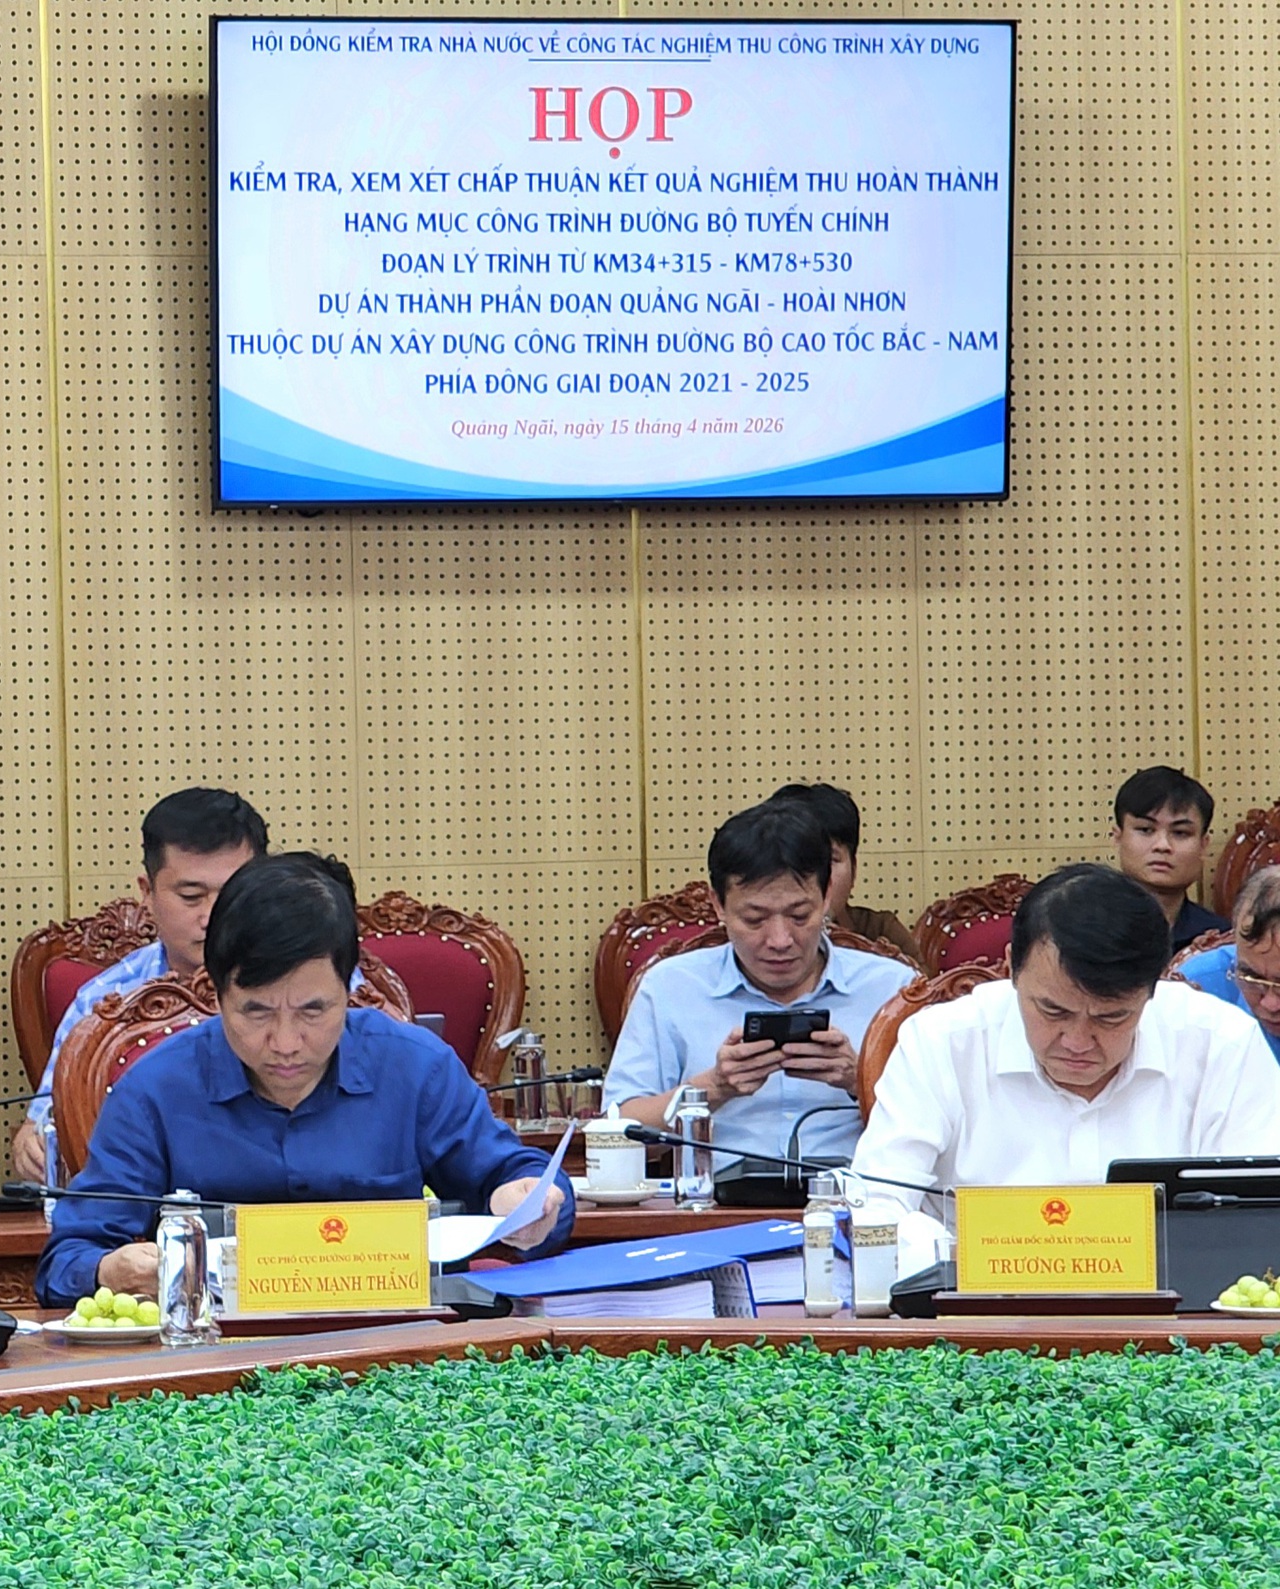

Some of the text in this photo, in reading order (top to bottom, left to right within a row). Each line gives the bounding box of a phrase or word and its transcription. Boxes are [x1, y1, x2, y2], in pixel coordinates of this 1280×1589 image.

[251, 27, 980, 59] HỘI ĐỒNG KIỂM TRA NHÀ NƯỚC VỀ CÔNG TÁC NGHIỆM THU CÔNG TRÌNH XÂY DỰNG
[527, 86, 695, 160] HỌP
[229, 160, 999, 198] KIỂM TRA, XEM XÉT CHẤP THUẬN KẾT QUẢ NGHIỆM THU HOÀN THÀNH
[344, 203, 889, 238] HẠNG MỤC CÔNG TRÌNH ĐƯỜNG BỘ TUYẾN CHÍNH
[381, 253, 444, 278] ĐOẠN
[453, 247, 479, 274] LÝ
[484, 247, 550, 274] TRÌNH
[557, 247, 586, 274] TỪ
[593, 252, 712, 274] KM34+315
[735, 252, 853, 273] KM78+530
[319, 292, 350, 319] DỰ
[357, 287, 389, 314] ÁN
[395, 288, 472, 314] THÀNH
[480, 284, 541, 314] PHẦN
[549, 293, 612, 319] ĐOẠN
[619, 286, 698, 315] QUẢNG
[706, 288, 759, 313] NGÃI
[783, 286, 836, 313] HOÀI
[844, 290, 906, 312] NHƠN
[226, 329, 303, 359] THUỘC
[311, 333, 344, 359] DỰ
[350, 327, 382, 354] ÁN
[390, 328, 436, 354] XÂY
[443, 332, 505, 359] DỰNG
[514, 328, 576, 354] CÔNG
[583, 328, 648, 354] TRÌNH
[656, 327, 735, 353] ĐƯỜNG
[743, 326, 773, 357] BỘ
[781, 332, 826, 353] CAO
[832, 322, 874, 352] TỐC
[882, 327, 926, 352] BẮC
[948, 330, 999, 351] NAM
[425, 368, 477, 394] PHÍA
[485, 368, 548, 394] ĐÔNG
[556, 373, 601, 394] GIAI
[609, 373, 671, 398] ĐOẠN
[679, 372, 731, 393] 2021
[756, 372, 810, 392] 2025
[513, 418, 558, 439] Ngãi,
[563, 417, 605, 439] ngày
[609, 418, 629, 435] 15
[634, 417, 682, 439] tháng
[686, 418, 698, 434] 4
[702, 417, 738, 434] năm
[743, 417, 784, 434] 2026
[248, 1266, 419, 1296] NGUYỄN MẠNH THẮNG
[988, 1256, 1124, 1274] TRƯƠNG KHOA
